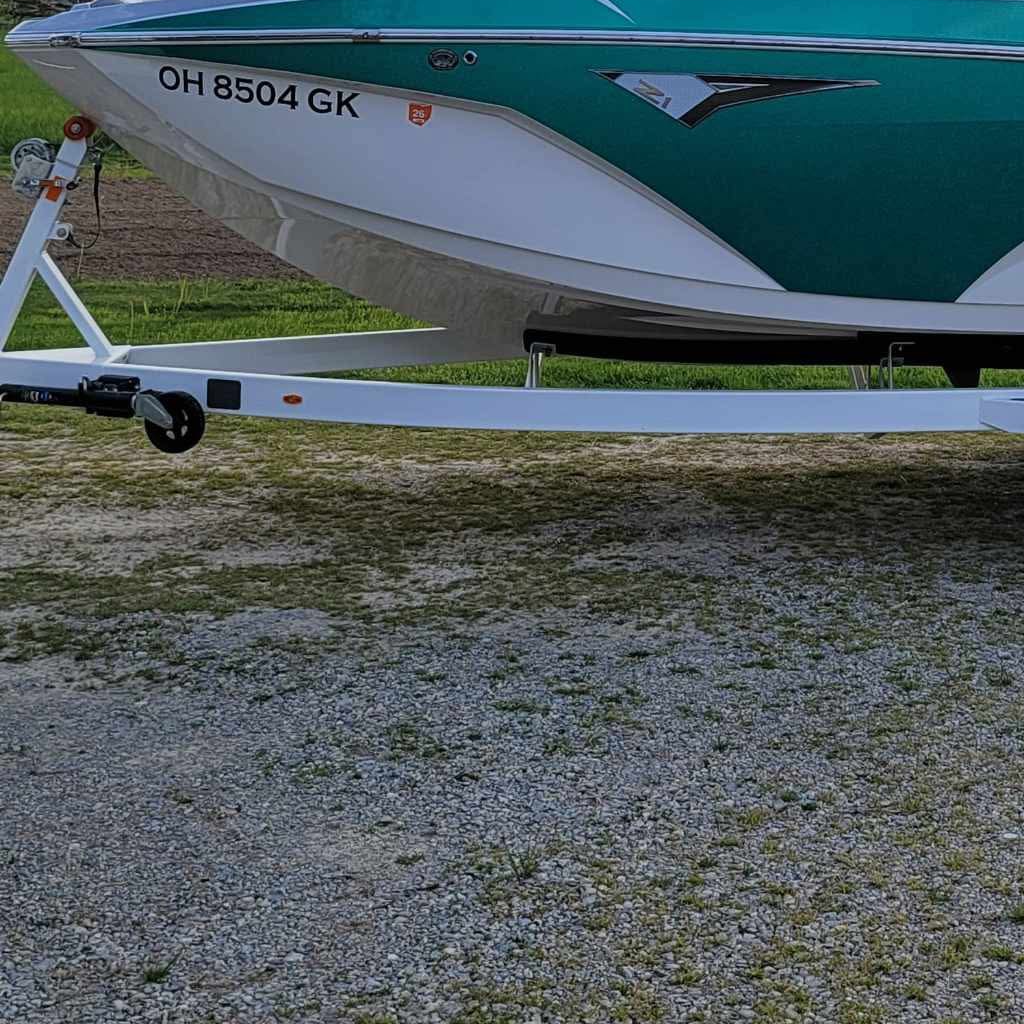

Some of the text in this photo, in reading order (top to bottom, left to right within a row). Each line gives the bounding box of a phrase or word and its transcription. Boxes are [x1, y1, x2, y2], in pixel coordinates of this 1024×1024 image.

[158, 65, 361, 119] OH 8504 GK
